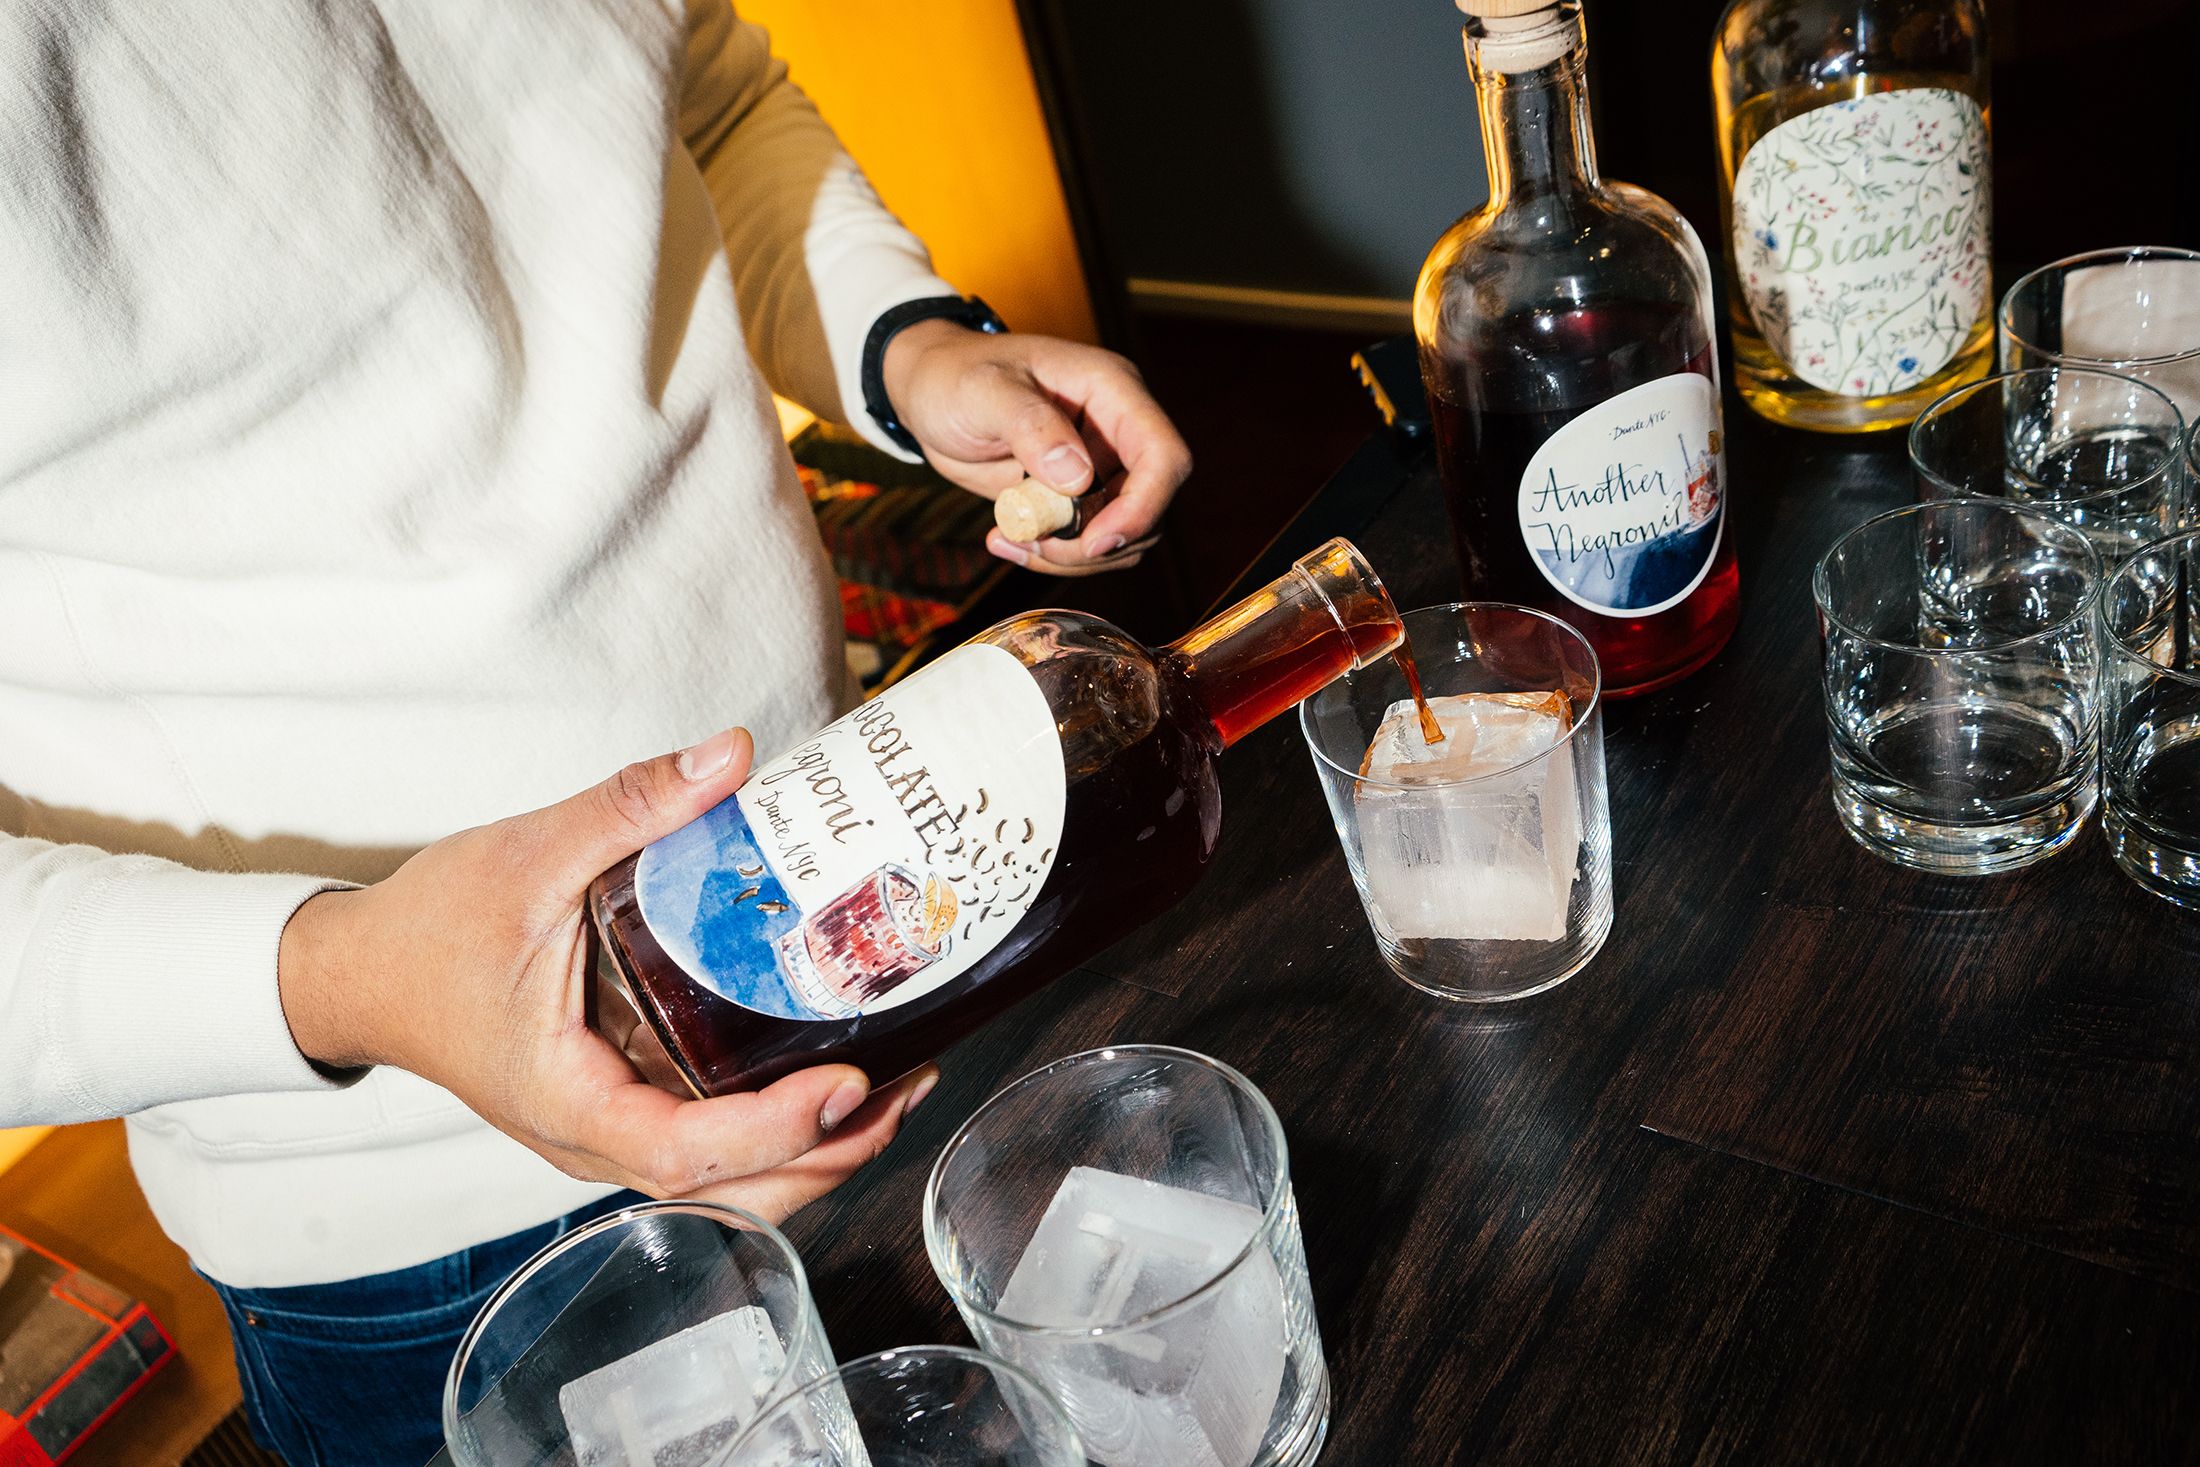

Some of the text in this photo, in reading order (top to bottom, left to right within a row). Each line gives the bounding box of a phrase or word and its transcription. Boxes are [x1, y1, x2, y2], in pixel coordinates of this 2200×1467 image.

[1775, 204, 1967, 274] Bianco
[1613, 419, 1644, 441] Dante
[1532, 461, 1676, 513] Another
[754, 790, 793, 840] Dante
